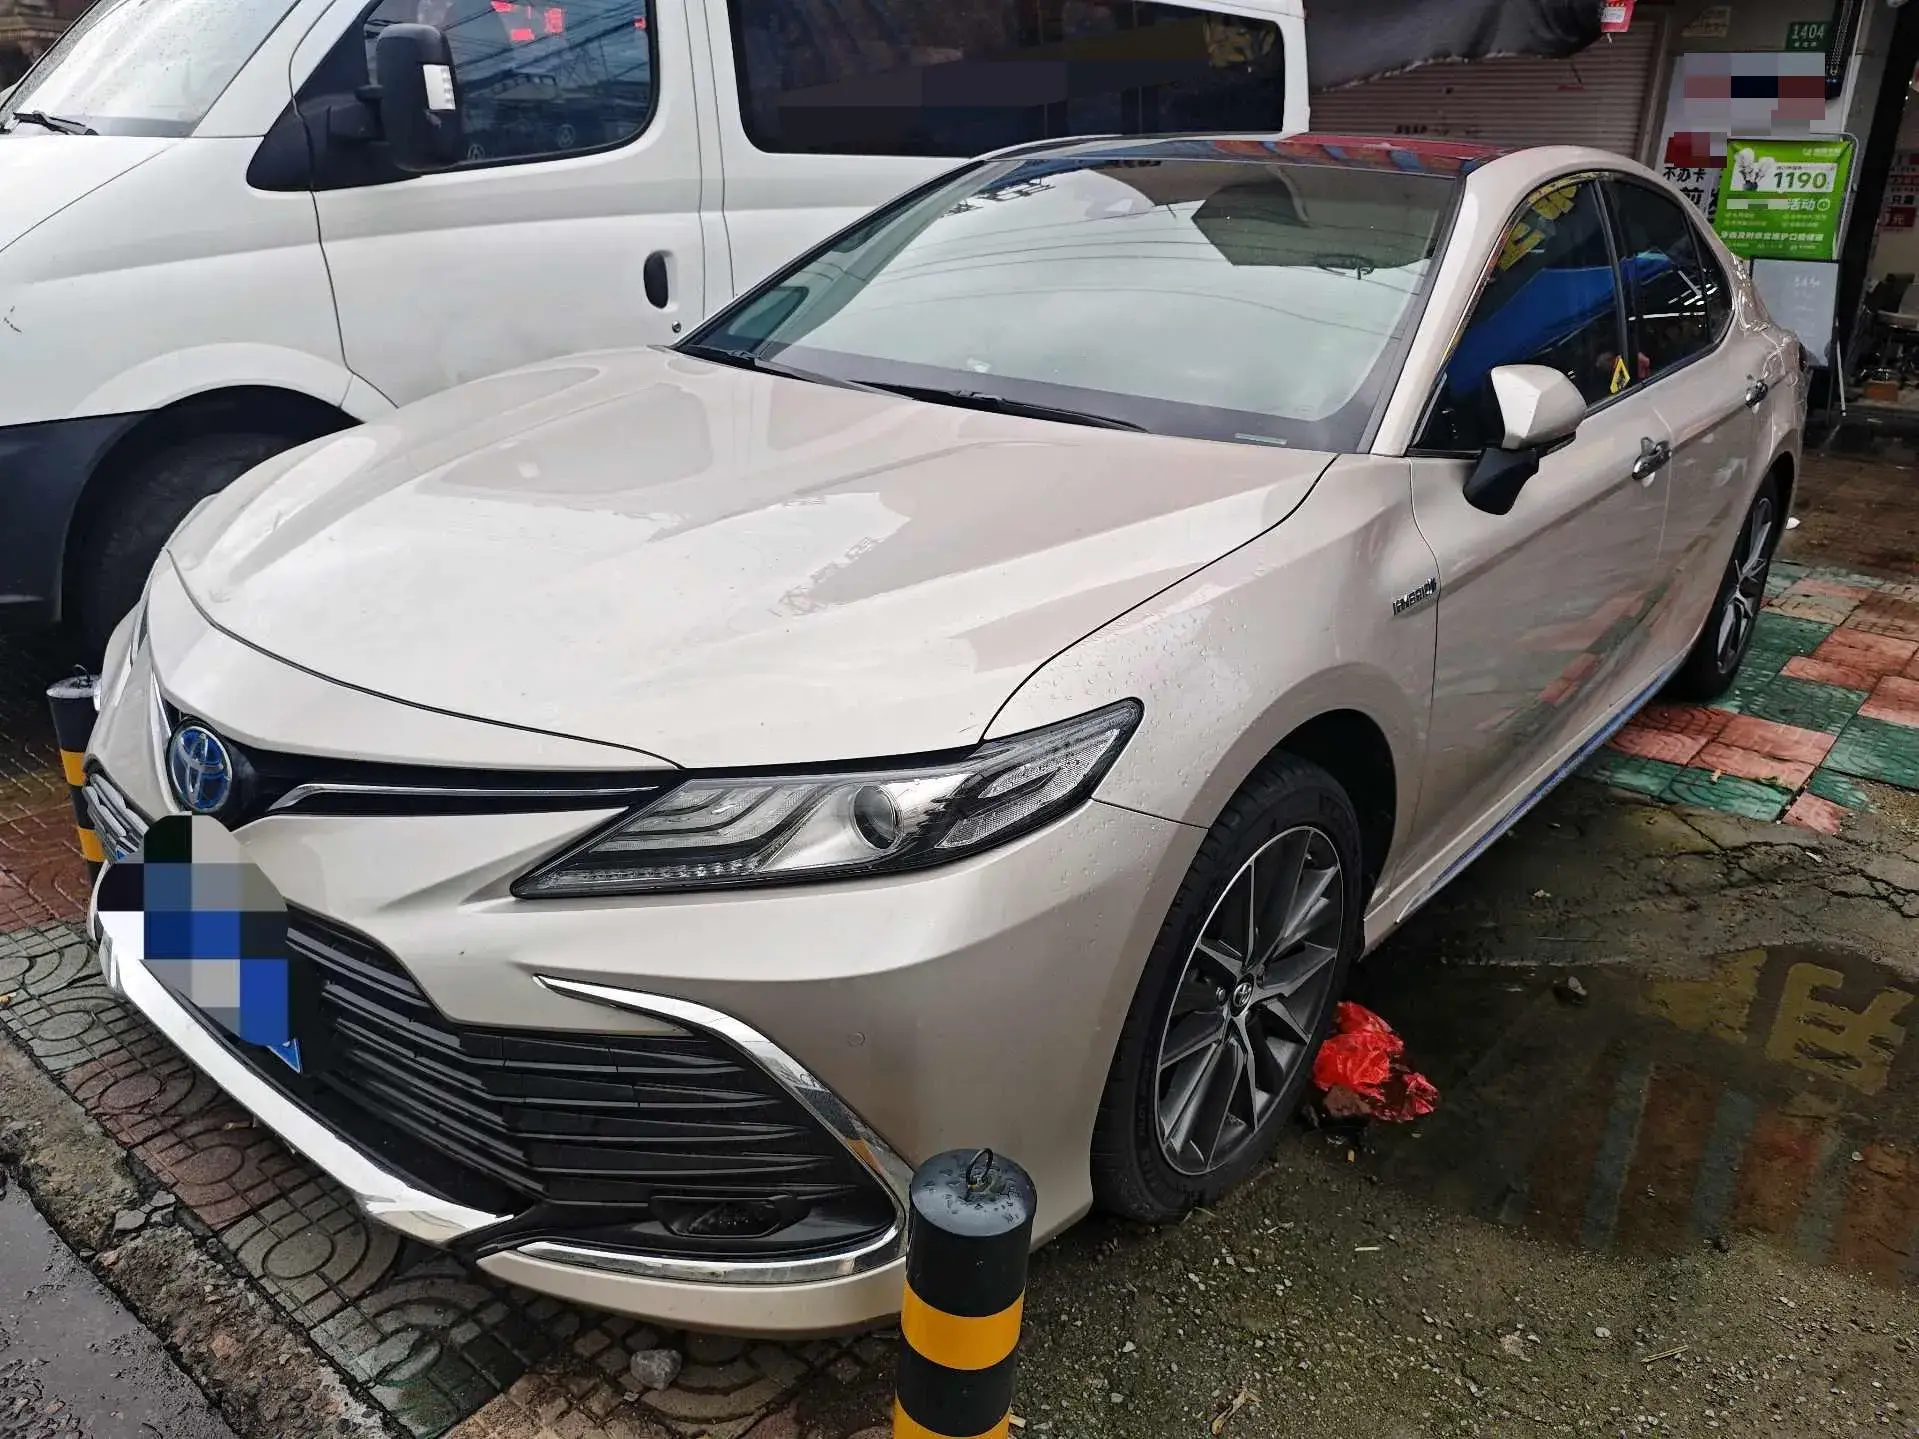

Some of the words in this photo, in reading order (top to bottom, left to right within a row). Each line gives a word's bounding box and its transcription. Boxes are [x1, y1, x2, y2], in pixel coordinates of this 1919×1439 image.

[1791, 24, 1825, 40] 1404
[1663, 167, 1706, 182] 不办卡
[1773, 172, 1828, 189] 1190
